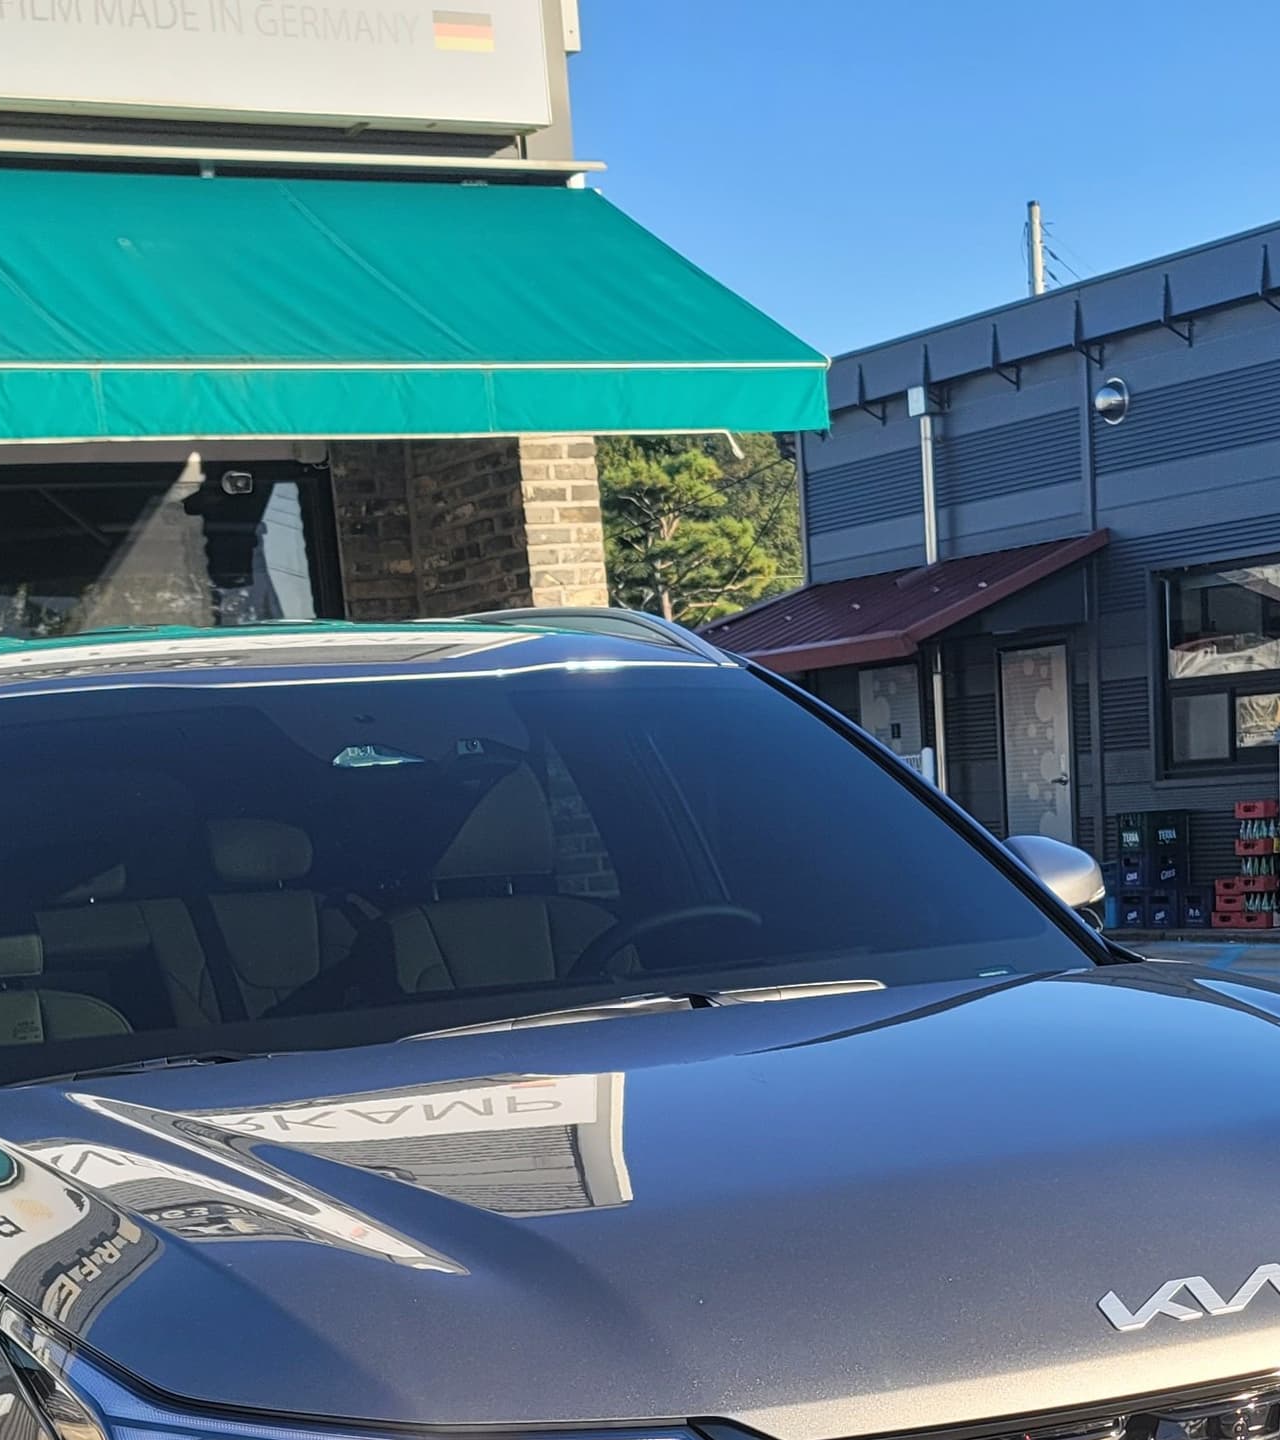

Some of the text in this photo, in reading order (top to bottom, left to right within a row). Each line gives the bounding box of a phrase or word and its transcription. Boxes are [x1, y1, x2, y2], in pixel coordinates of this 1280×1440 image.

[93, 0, 200, 31] MADE
[209, 0, 244, 35] IN
[254, 1, 419, 44] GERMANY
